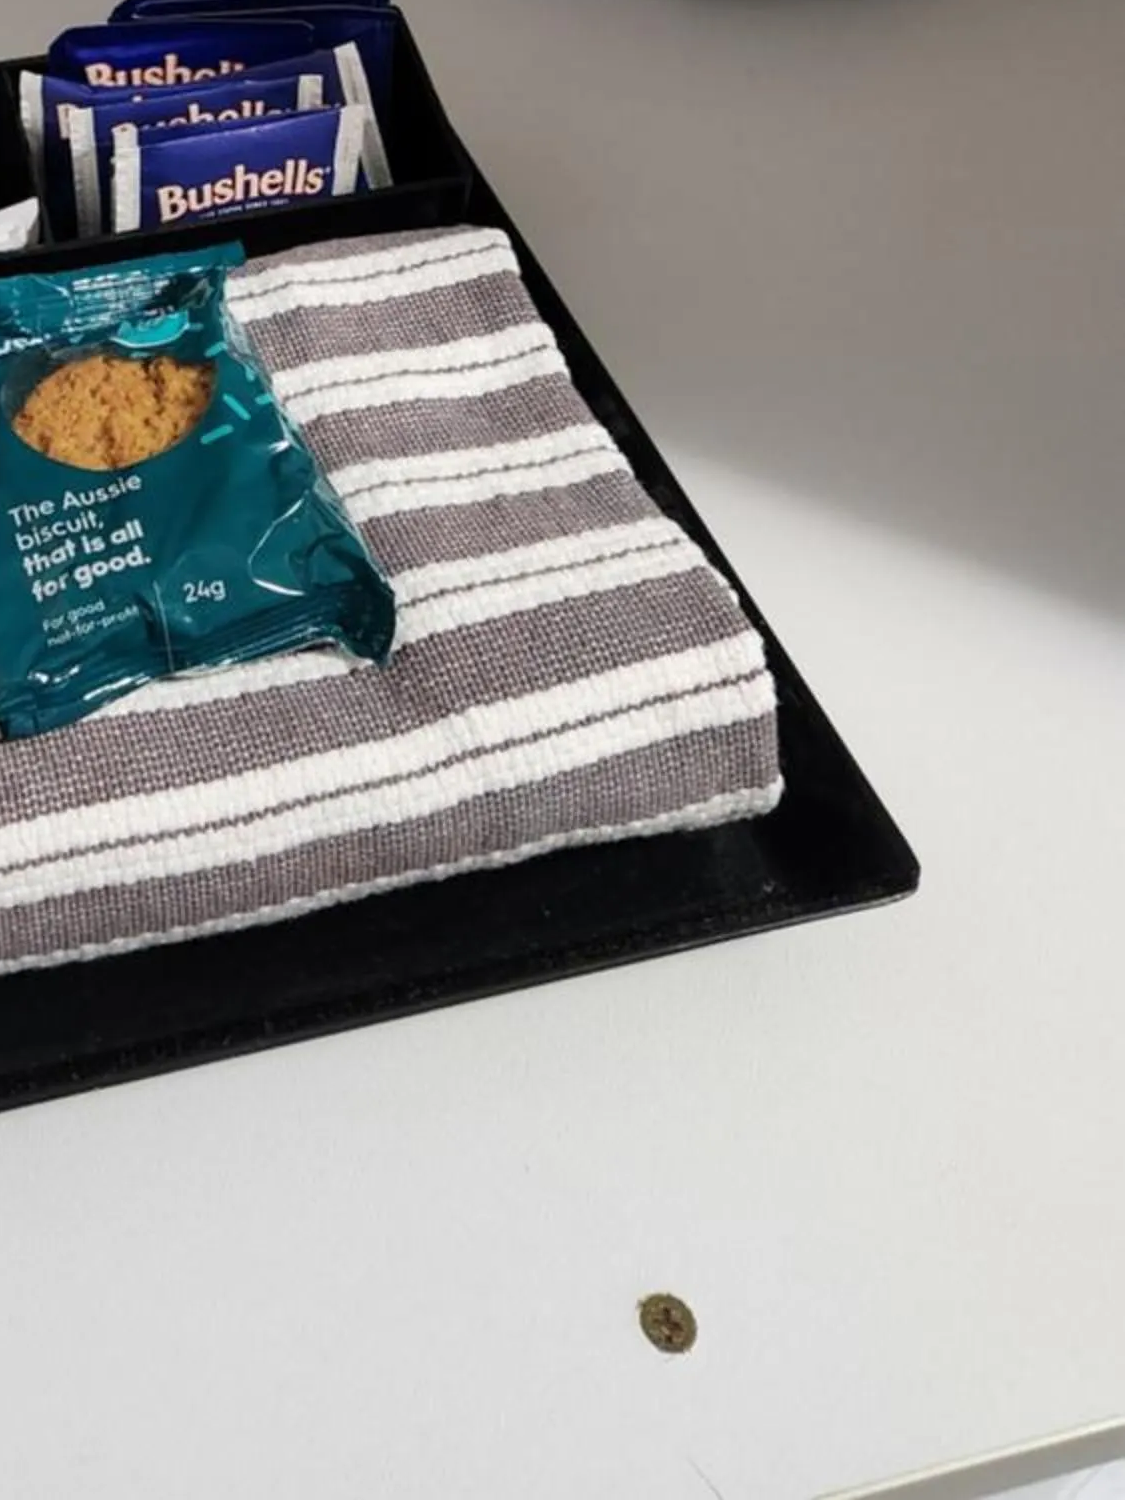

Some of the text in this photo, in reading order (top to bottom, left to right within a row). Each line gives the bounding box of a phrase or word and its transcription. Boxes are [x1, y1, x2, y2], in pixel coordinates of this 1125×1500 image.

[156, 158, 326, 225] Bushells
[8, 474, 143, 528] The Aussie
[15, 509, 105, 551] biscuit,
[22, 518, 145, 577] that is all
[31, 545, 153, 603] for good.
[182, 578, 227, 604] 24g
[67, 598, 106, 625] good
